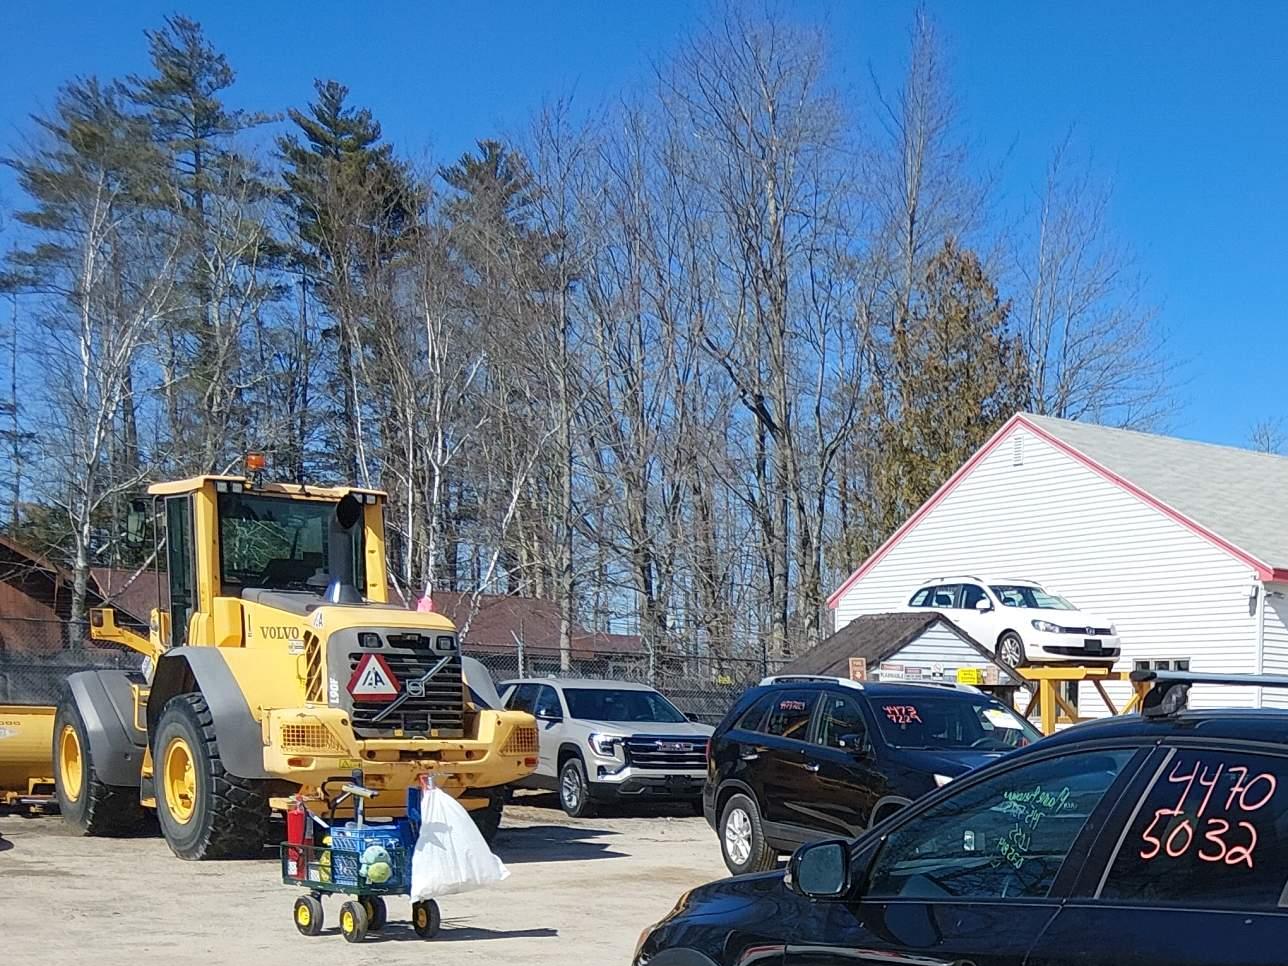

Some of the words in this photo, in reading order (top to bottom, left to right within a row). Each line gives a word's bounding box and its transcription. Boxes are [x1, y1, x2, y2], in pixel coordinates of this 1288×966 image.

[259, 626, 300, 640] VOLVO
[329, 677, 340, 704] L90F
[1168, 760, 1277, 818] 4470
[1140, 808, 1258, 868] 5032
